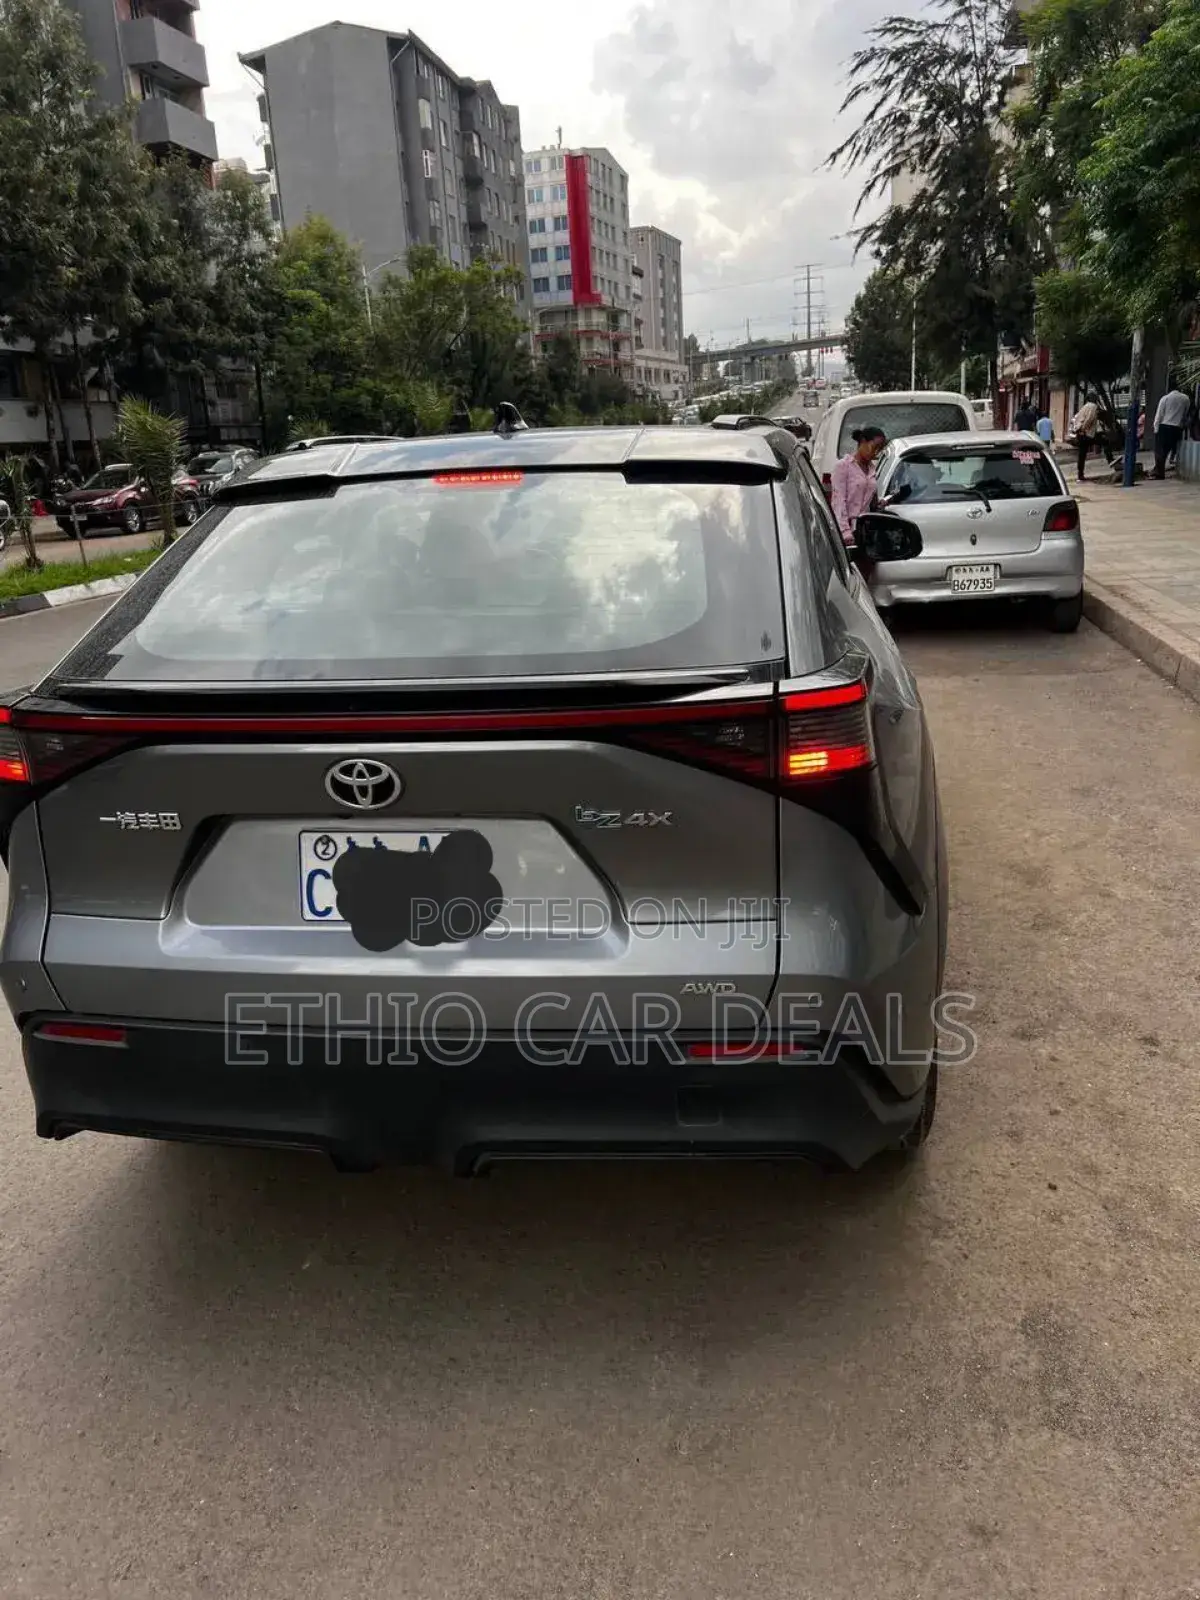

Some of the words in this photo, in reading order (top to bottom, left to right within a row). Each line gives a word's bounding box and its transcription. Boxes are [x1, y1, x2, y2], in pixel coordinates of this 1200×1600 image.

[99, 811, 181, 830] 一汽丰田
[680, 983, 736, 995] AWD
